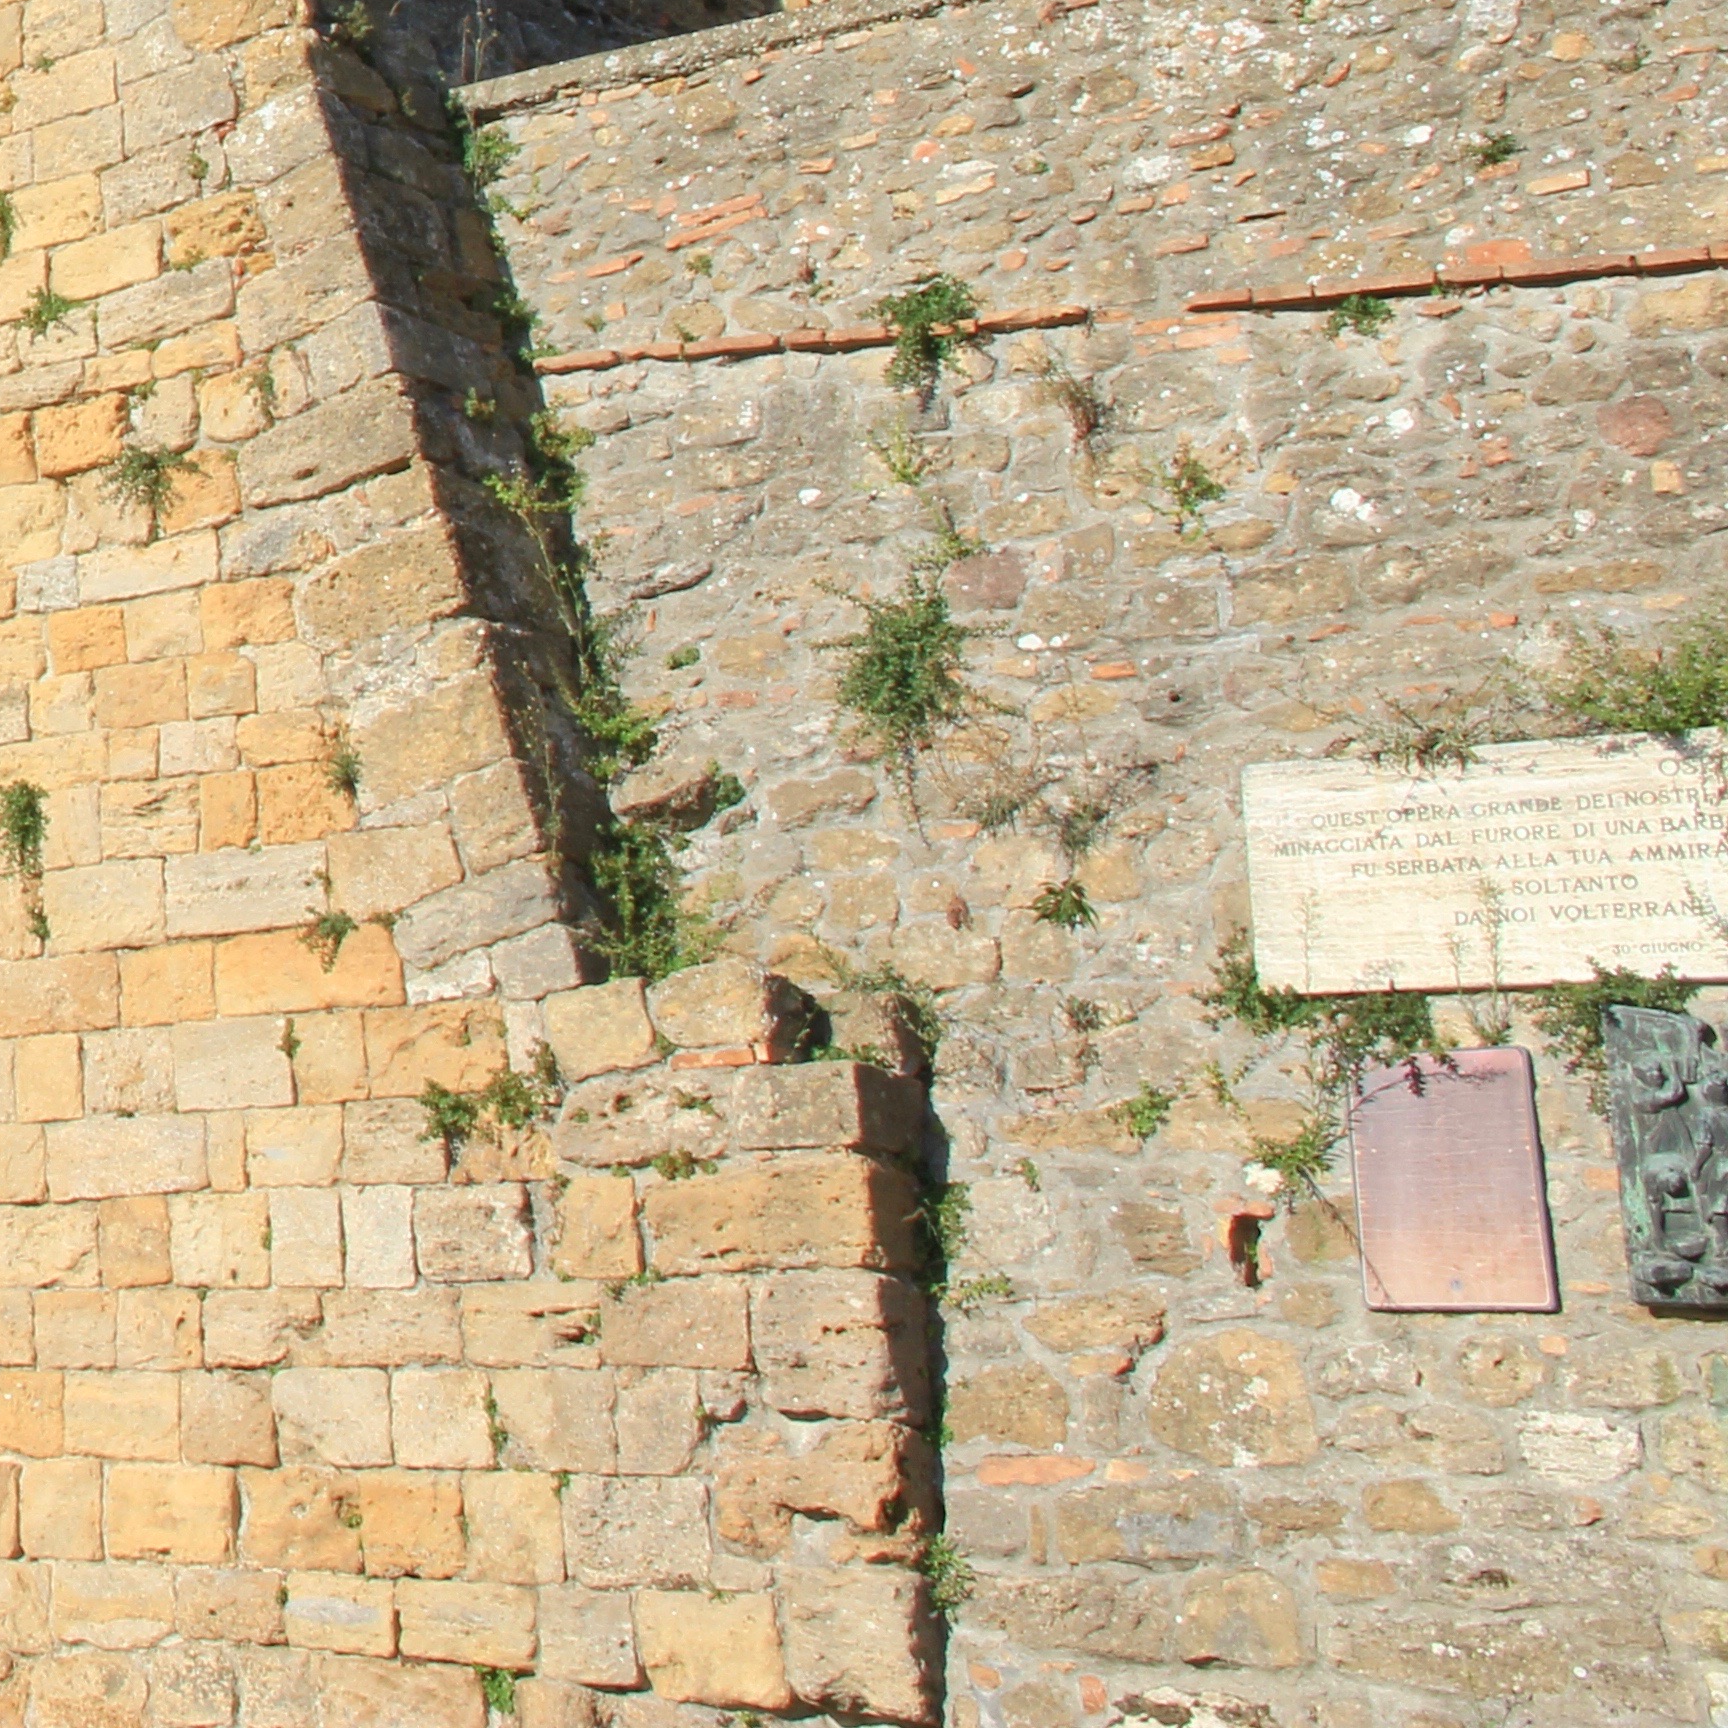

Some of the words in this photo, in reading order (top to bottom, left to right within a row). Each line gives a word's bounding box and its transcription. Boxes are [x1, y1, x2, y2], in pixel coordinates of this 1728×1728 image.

[1471, 797, 1562, 818] GRANDE
[1576, 792, 1614, 811] DEI
[1274, 836, 1403, 857] MINACCIATA
[1415, 830, 1459, 849] DAL
[1471, 823, 1561, 844] FURORE
[1572, 821, 1595, 839] DI
[1605, 818, 1651, 836] UNA
[1659, 812, 1728, 832] BARB
[1350, 862, 1377, 878] FU
[1385, 855, 1482, 877] SERBATA
[1495, 851, 1558, 870] ALLA
[1568, 848, 1614, 866] TUA
[1511, 873, 1639, 896] SOLTANTO
[1454, 910, 1484, 927] DA
[1496, 905, 1537, 924] NOI
[1549, 899, 1712, 922] VOLTERRAN
[1640, 940, 1704, 955] GIUGNO
